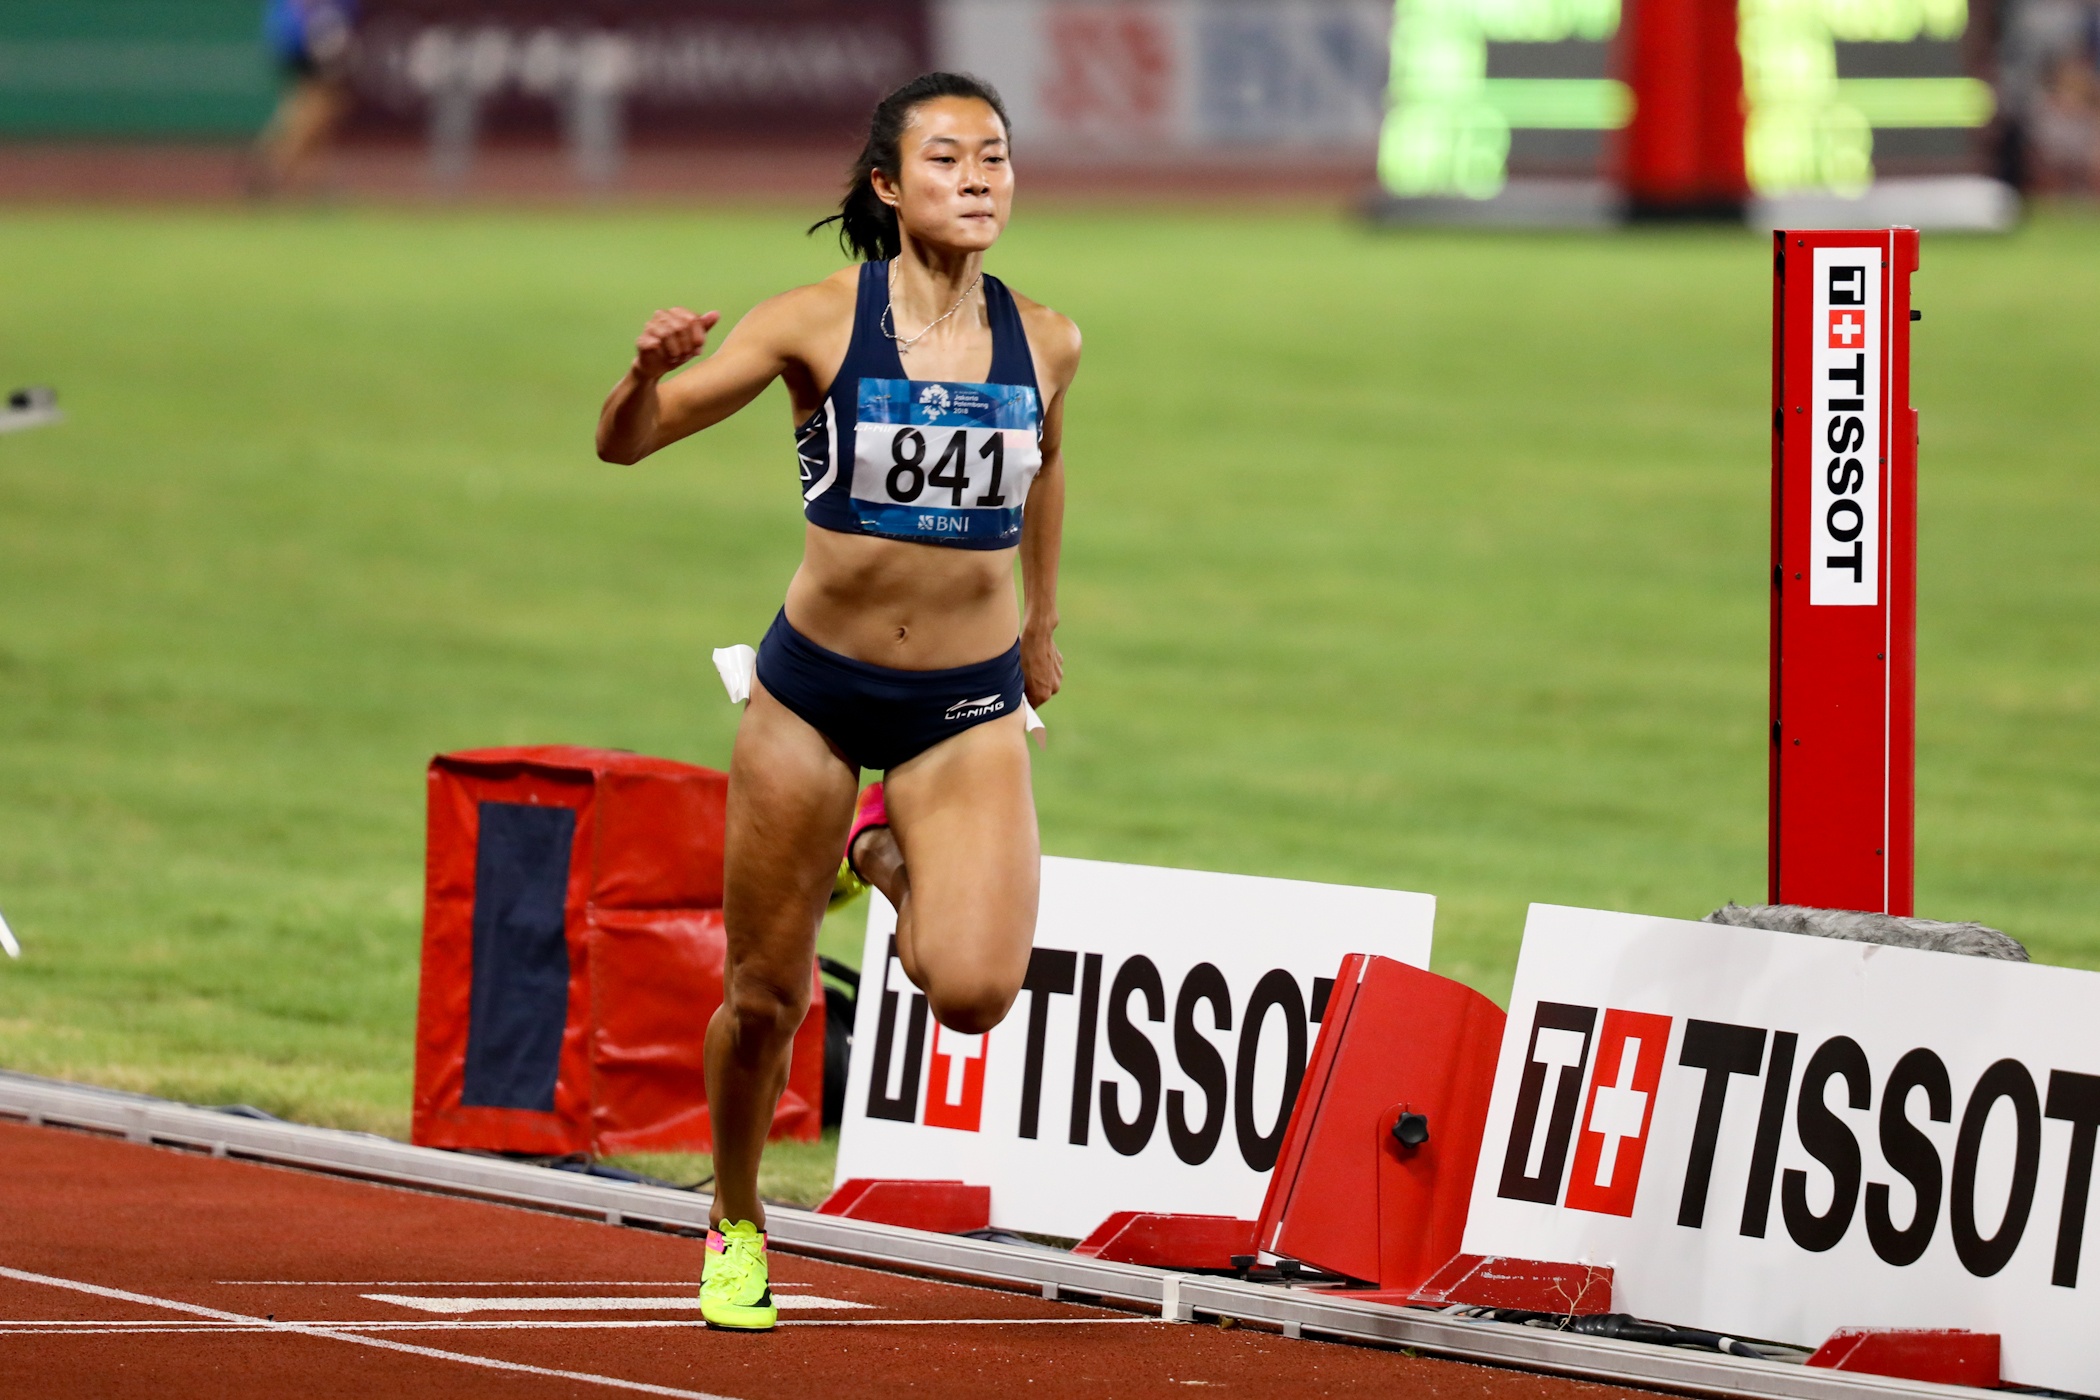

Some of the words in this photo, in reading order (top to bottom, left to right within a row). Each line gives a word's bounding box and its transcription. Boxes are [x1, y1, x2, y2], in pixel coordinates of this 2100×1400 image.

[953, 394, 979, 402] Jakarta
[953, 400, 989, 409] Palembang
[953, 407, 969, 415] 2018
[886, 427, 1005, 506] 841
[1827, 353, 1865, 583] TISSOT
[936, 515, 970, 532] BNI
[944, 700, 1005, 720] LI-NING
[1677, 1018, 2100, 1289] TISSOT
